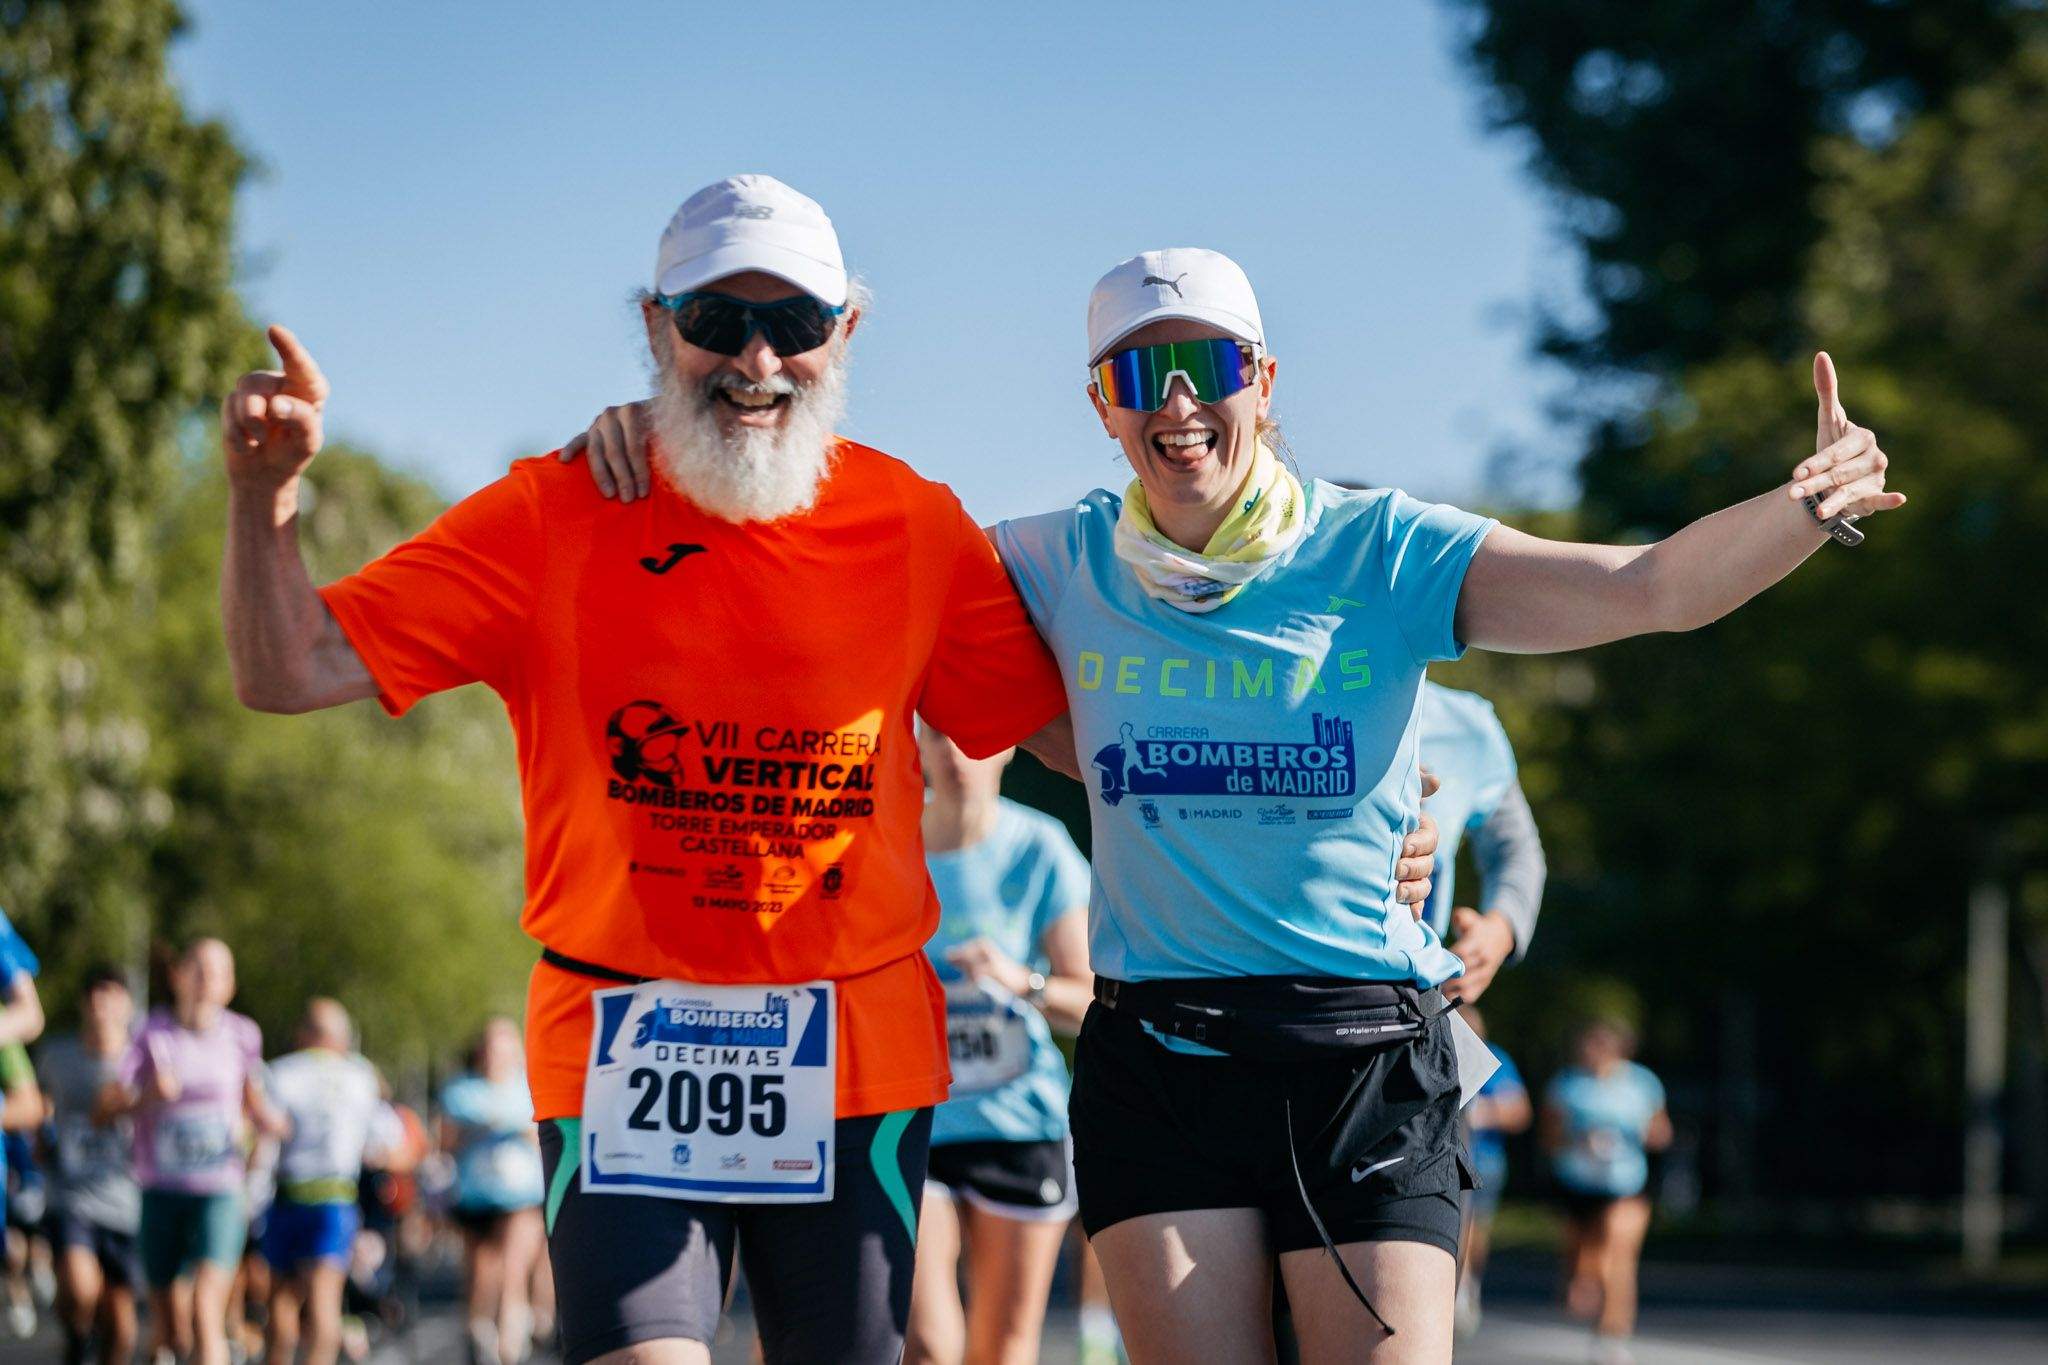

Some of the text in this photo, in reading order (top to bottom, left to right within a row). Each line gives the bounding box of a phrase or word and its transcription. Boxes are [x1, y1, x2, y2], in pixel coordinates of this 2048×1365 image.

[1077, 649, 1371, 698] DECIMAS
[695, 721, 881, 756] VII CARRERA
[1147, 726, 1209, 739] CARRERA
[1149, 743, 1348, 769] BOMBEROS
[1226, 769, 1349, 794] de MADRID
[607, 778, 874, 818] BOMBEROS DE MADRID
[1194, 808, 1243, 820] MADRID
[650, 813, 838, 841] TORRE EMPERADOR
[680, 836, 805, 859] CASTELLANA
[670, 1009, 784, 1029] BOMBEROS
[655, 1045, 780, 1067] DECIMAS
[628, 1067, 788, 1138] 2095
